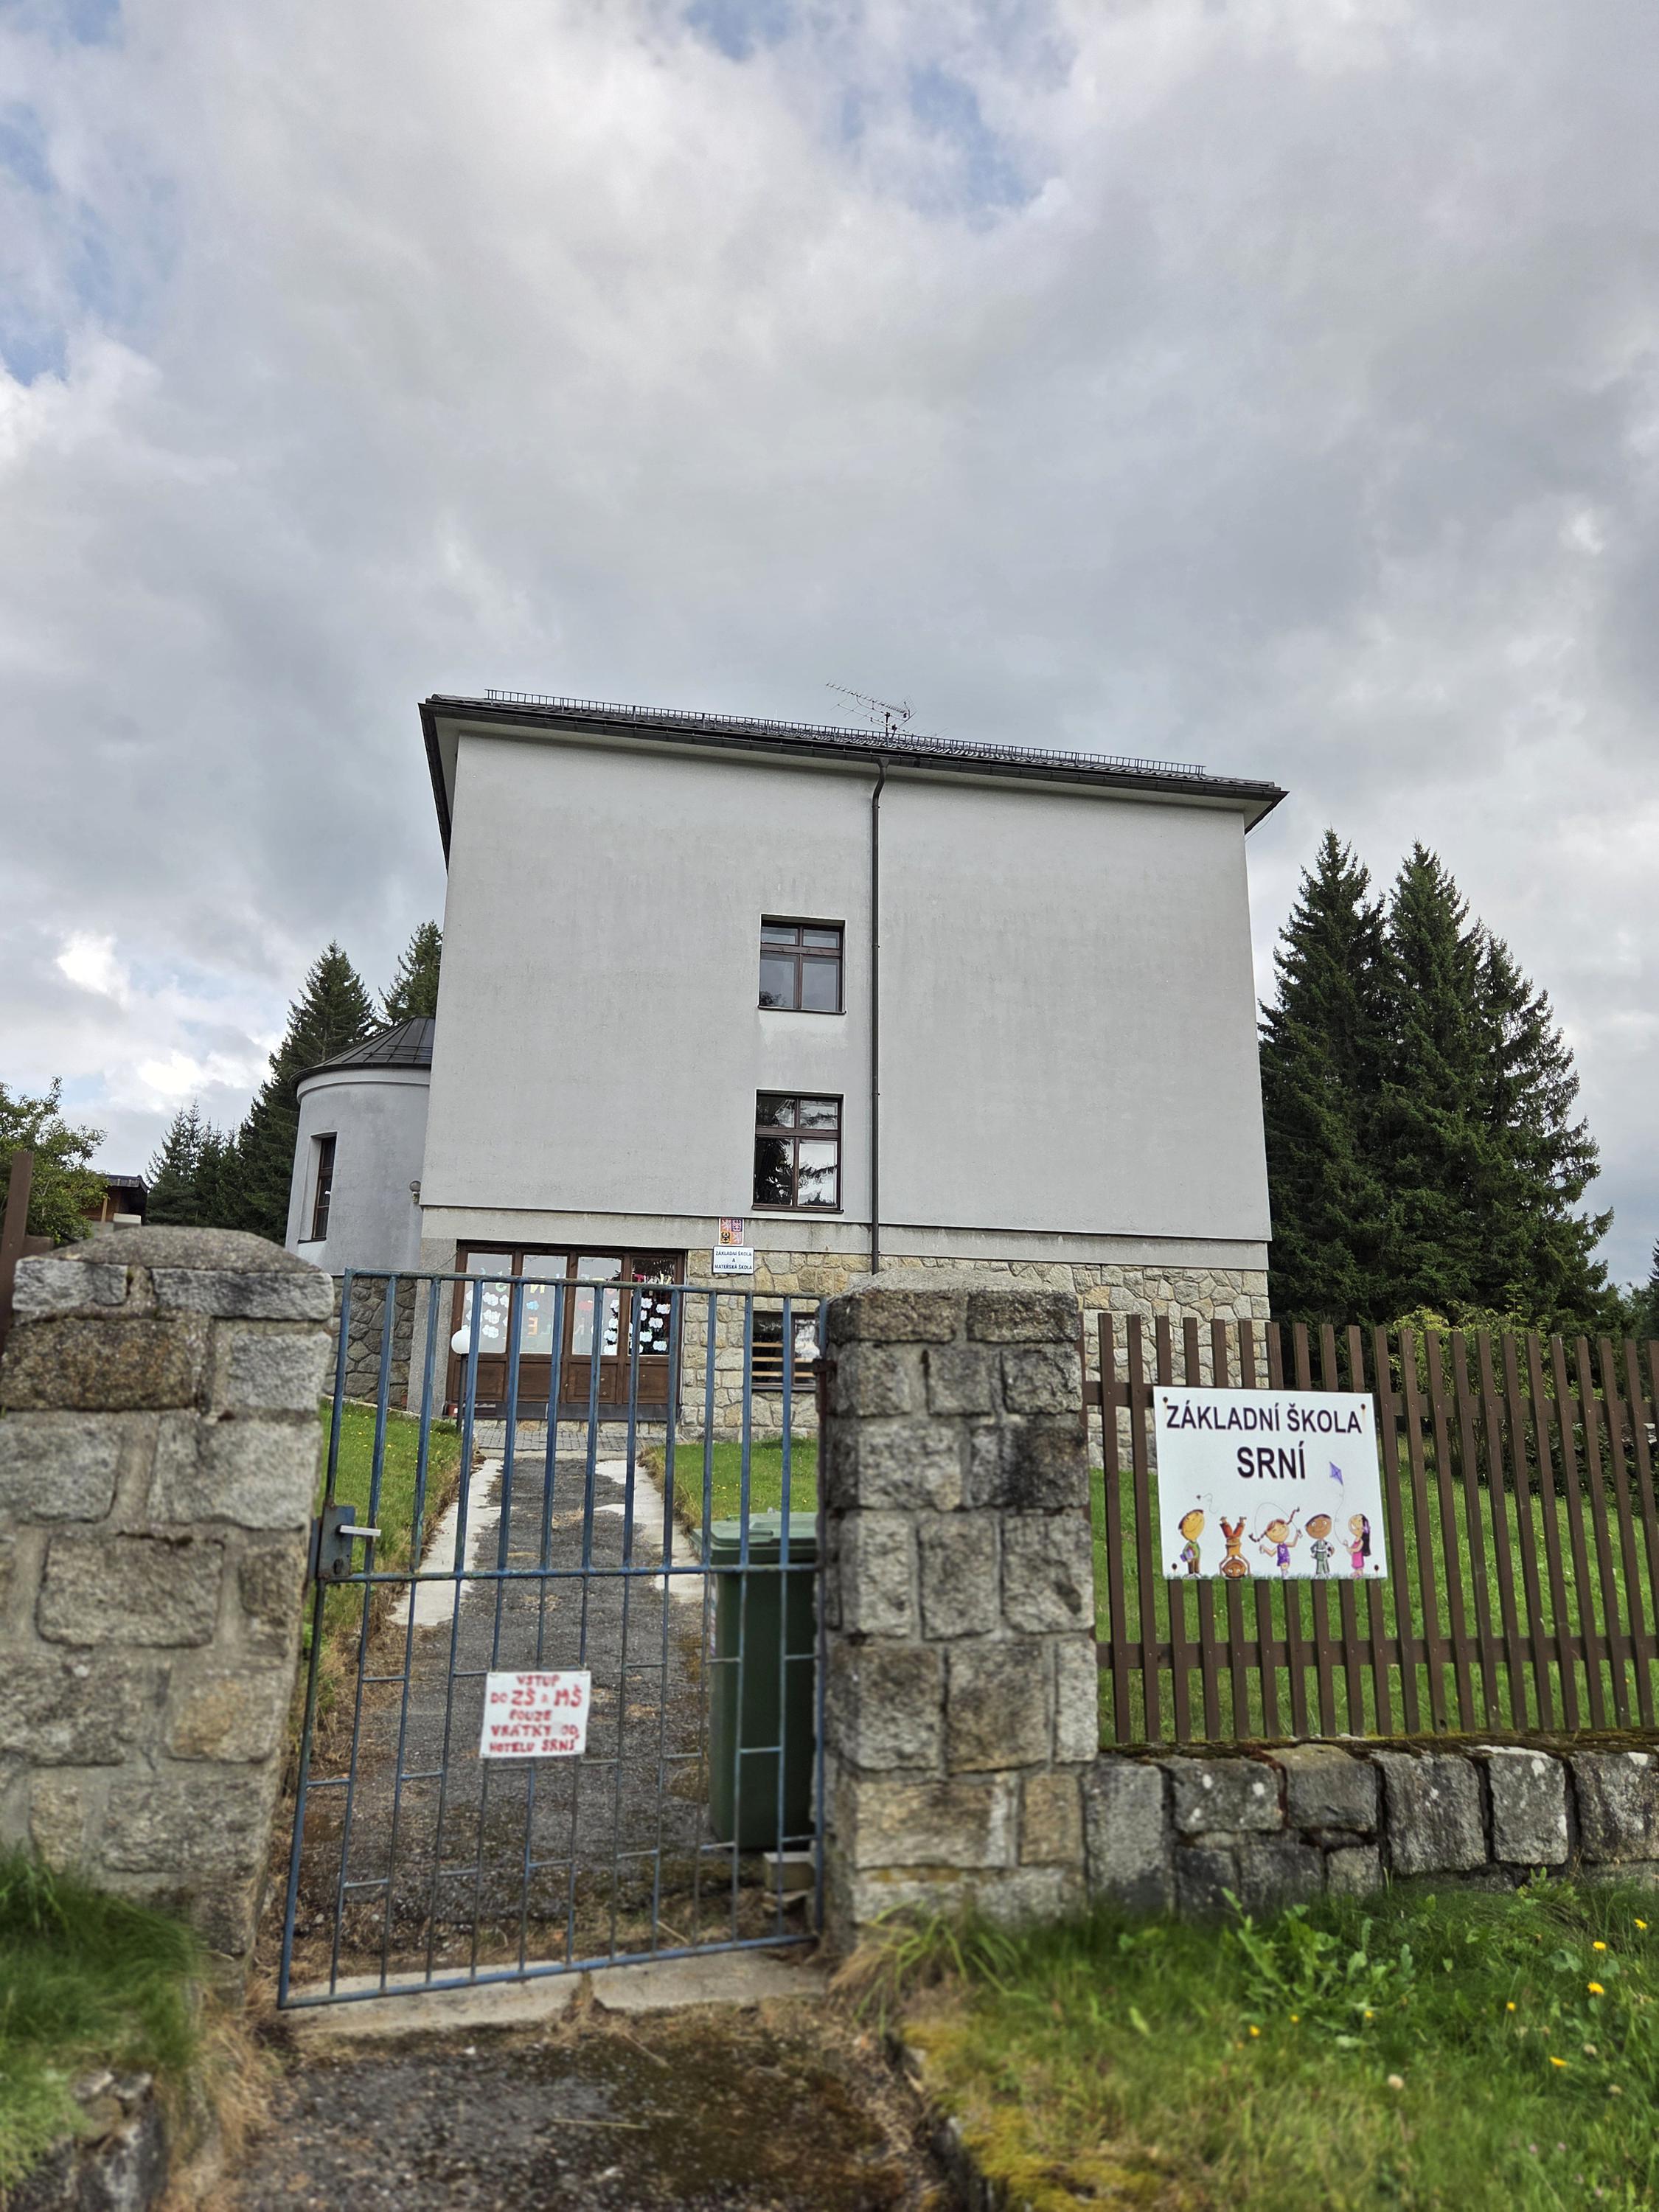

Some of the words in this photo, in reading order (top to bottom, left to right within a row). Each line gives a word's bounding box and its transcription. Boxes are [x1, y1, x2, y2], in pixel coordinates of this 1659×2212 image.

[1166, 1399, 1281, 1432] ZÁKLADNÍ
[1286, 1402, 1363, 1433] ŠKOLA
[1237, 1440, 1306, 1480] SRNÍ
[517, 1674, 560, 1686] VSTUP
[490, 1691, 509, 1704] DO
[510, 1687, 536, 1706] ZŠ
[554, 1683, 582, 1708] MŠ
[509, 1709, 552, 1722] POUZE
[490, 1742, 535, 1753] HOTELU
